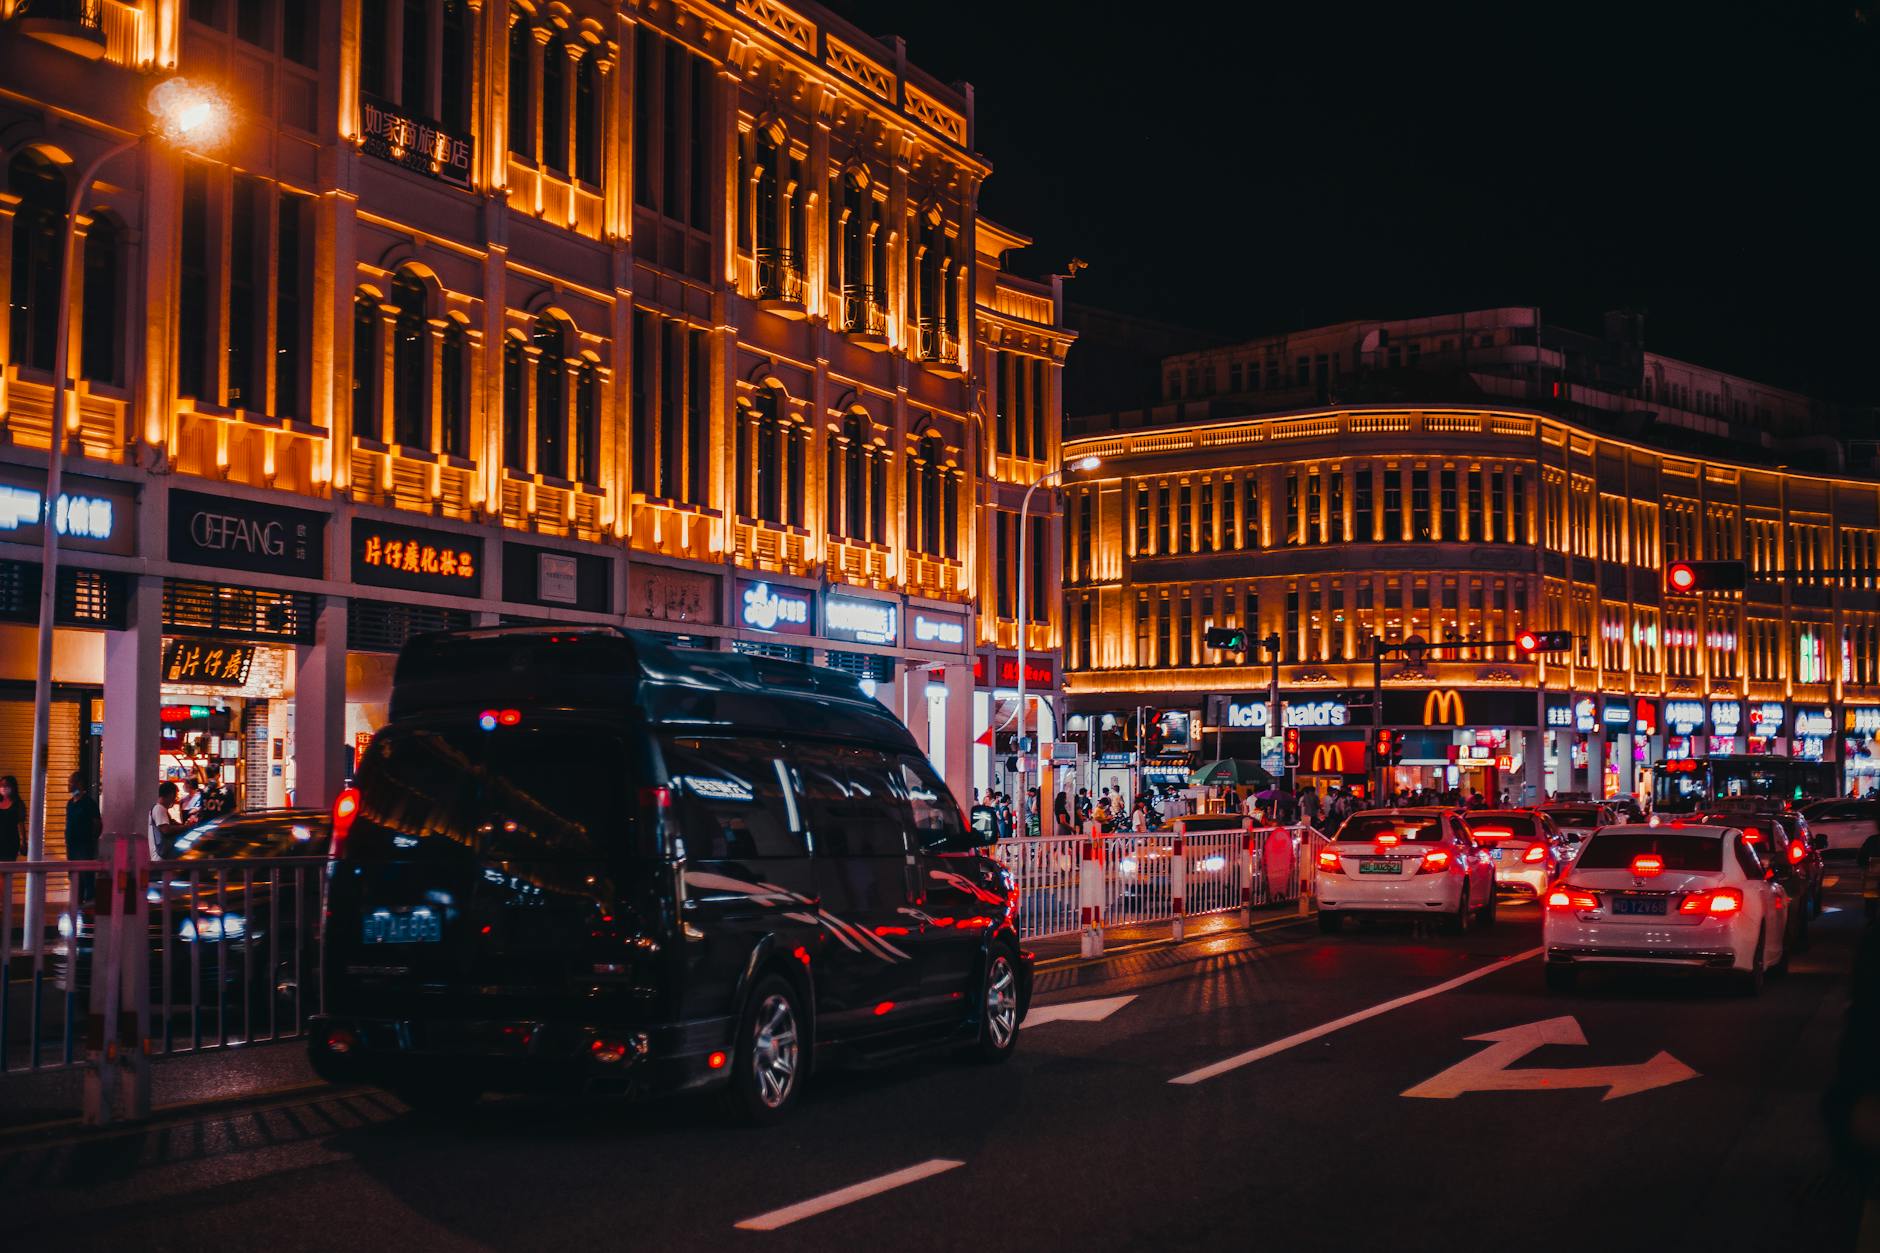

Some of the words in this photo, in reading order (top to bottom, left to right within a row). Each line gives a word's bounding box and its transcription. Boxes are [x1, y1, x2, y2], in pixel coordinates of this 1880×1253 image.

[364, 104, 469, 169] 如家商旅酒店
